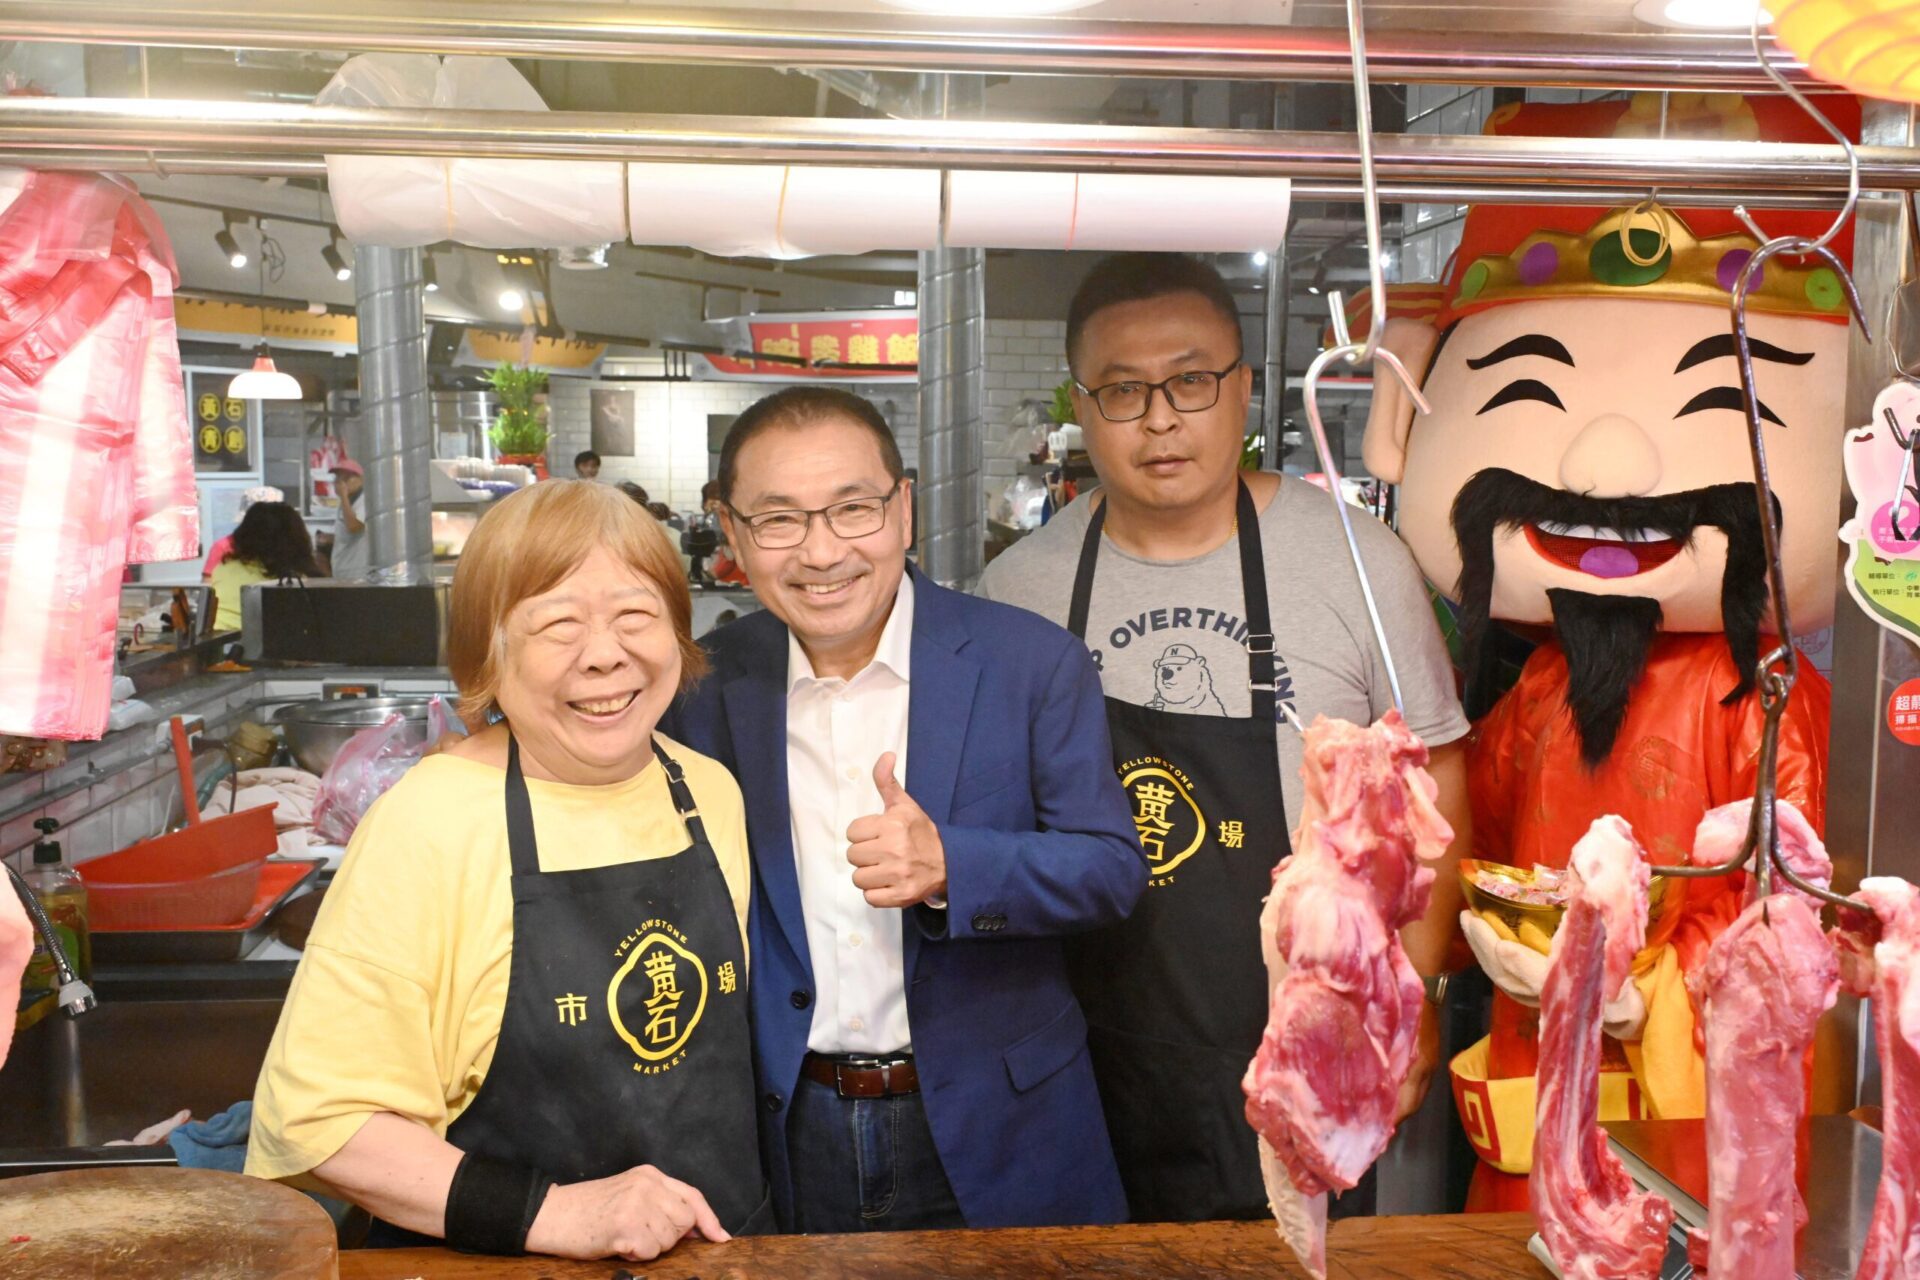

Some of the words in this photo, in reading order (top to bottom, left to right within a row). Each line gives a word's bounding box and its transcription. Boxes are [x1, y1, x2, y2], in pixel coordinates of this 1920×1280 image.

[1118, 756, 1194, 790] YELLOWSTONE
[1132, 782, 1176, 860] 黃石
[1218, 820, 1245, 848] 場
[1148, 876, 1175, 886] KET
[614, 919, 688, 957] YELLOWSTONE
[717, 961, 737, 994] 場
[554, 992, 588, 1026] 市
[643, 950, 685, 1043] 黃石
[633, 1049, 687, 1074] MARKET
